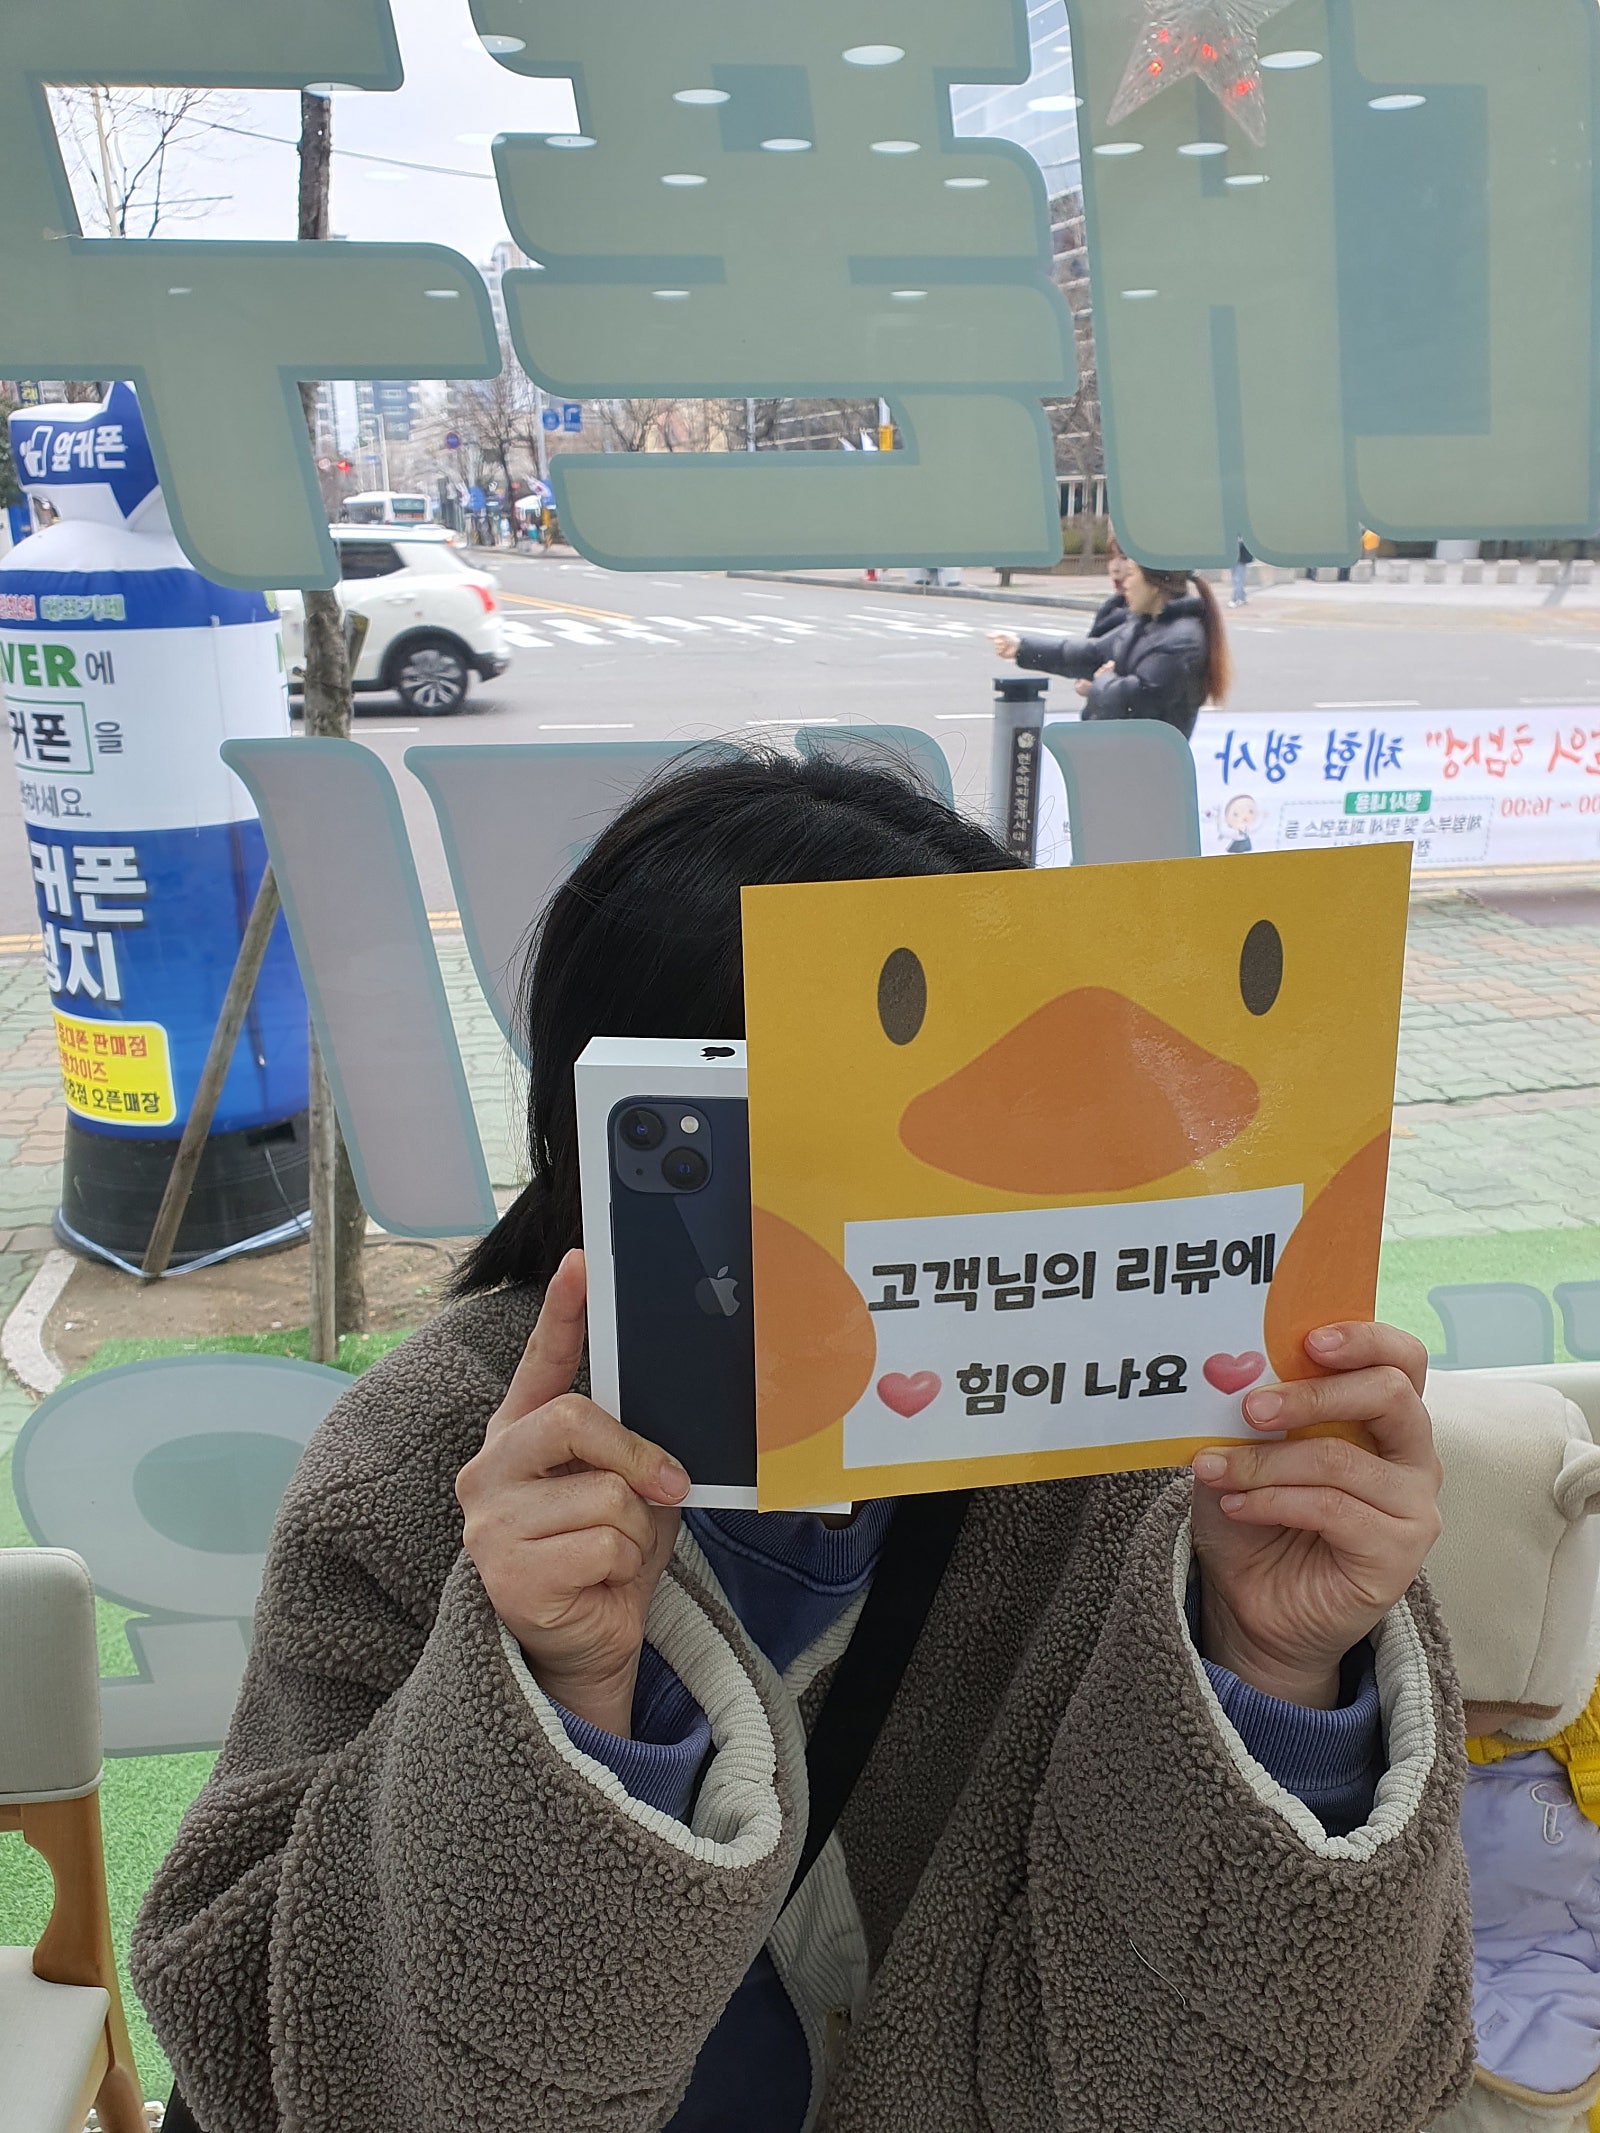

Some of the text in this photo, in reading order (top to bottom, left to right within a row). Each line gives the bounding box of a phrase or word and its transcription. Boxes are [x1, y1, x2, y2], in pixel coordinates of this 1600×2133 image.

[94, 720, 124, 755] 을
[92, 1033, 148, 1058] 판매점
[92, 1088, 160, 1113] 오픈매장
[868, 1233, 1276, 1312] 고객님의 리뷰에
[956, 1354, 1188, 1416] 힘이 나요
